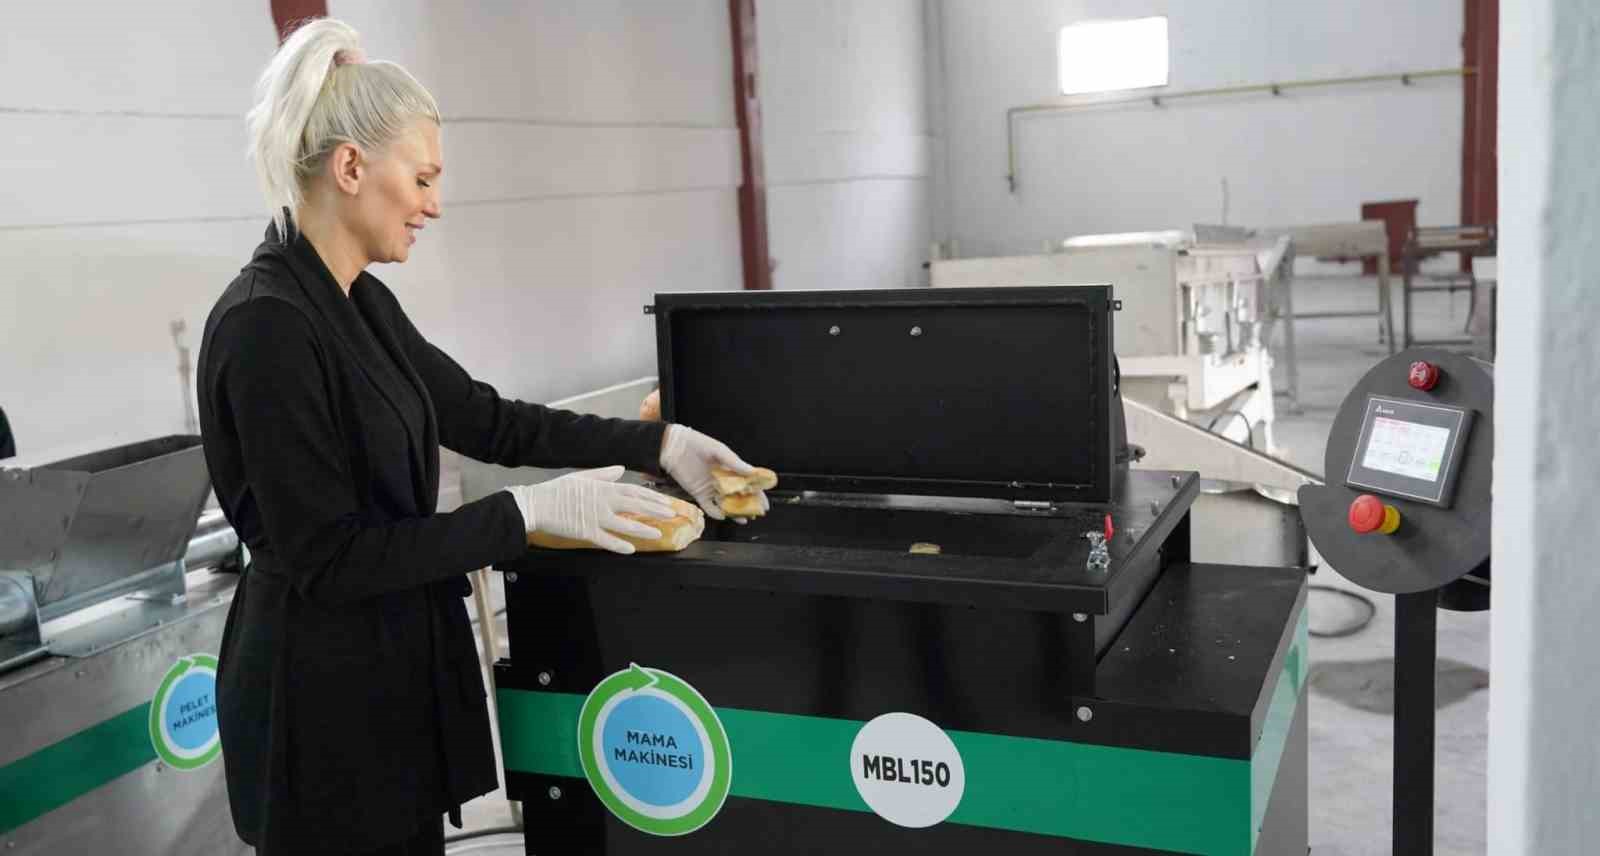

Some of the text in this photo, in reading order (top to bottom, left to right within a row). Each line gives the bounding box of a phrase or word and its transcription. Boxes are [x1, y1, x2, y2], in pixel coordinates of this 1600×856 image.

[179, 694, 208, 714] PELET
[172, 704, 216, 731] MAKİNES
[627, 730, 677, 749] MAMA
[614, 748, 694, 770] MAKİNESİ
[863, 755, 951, 788] MBL150
